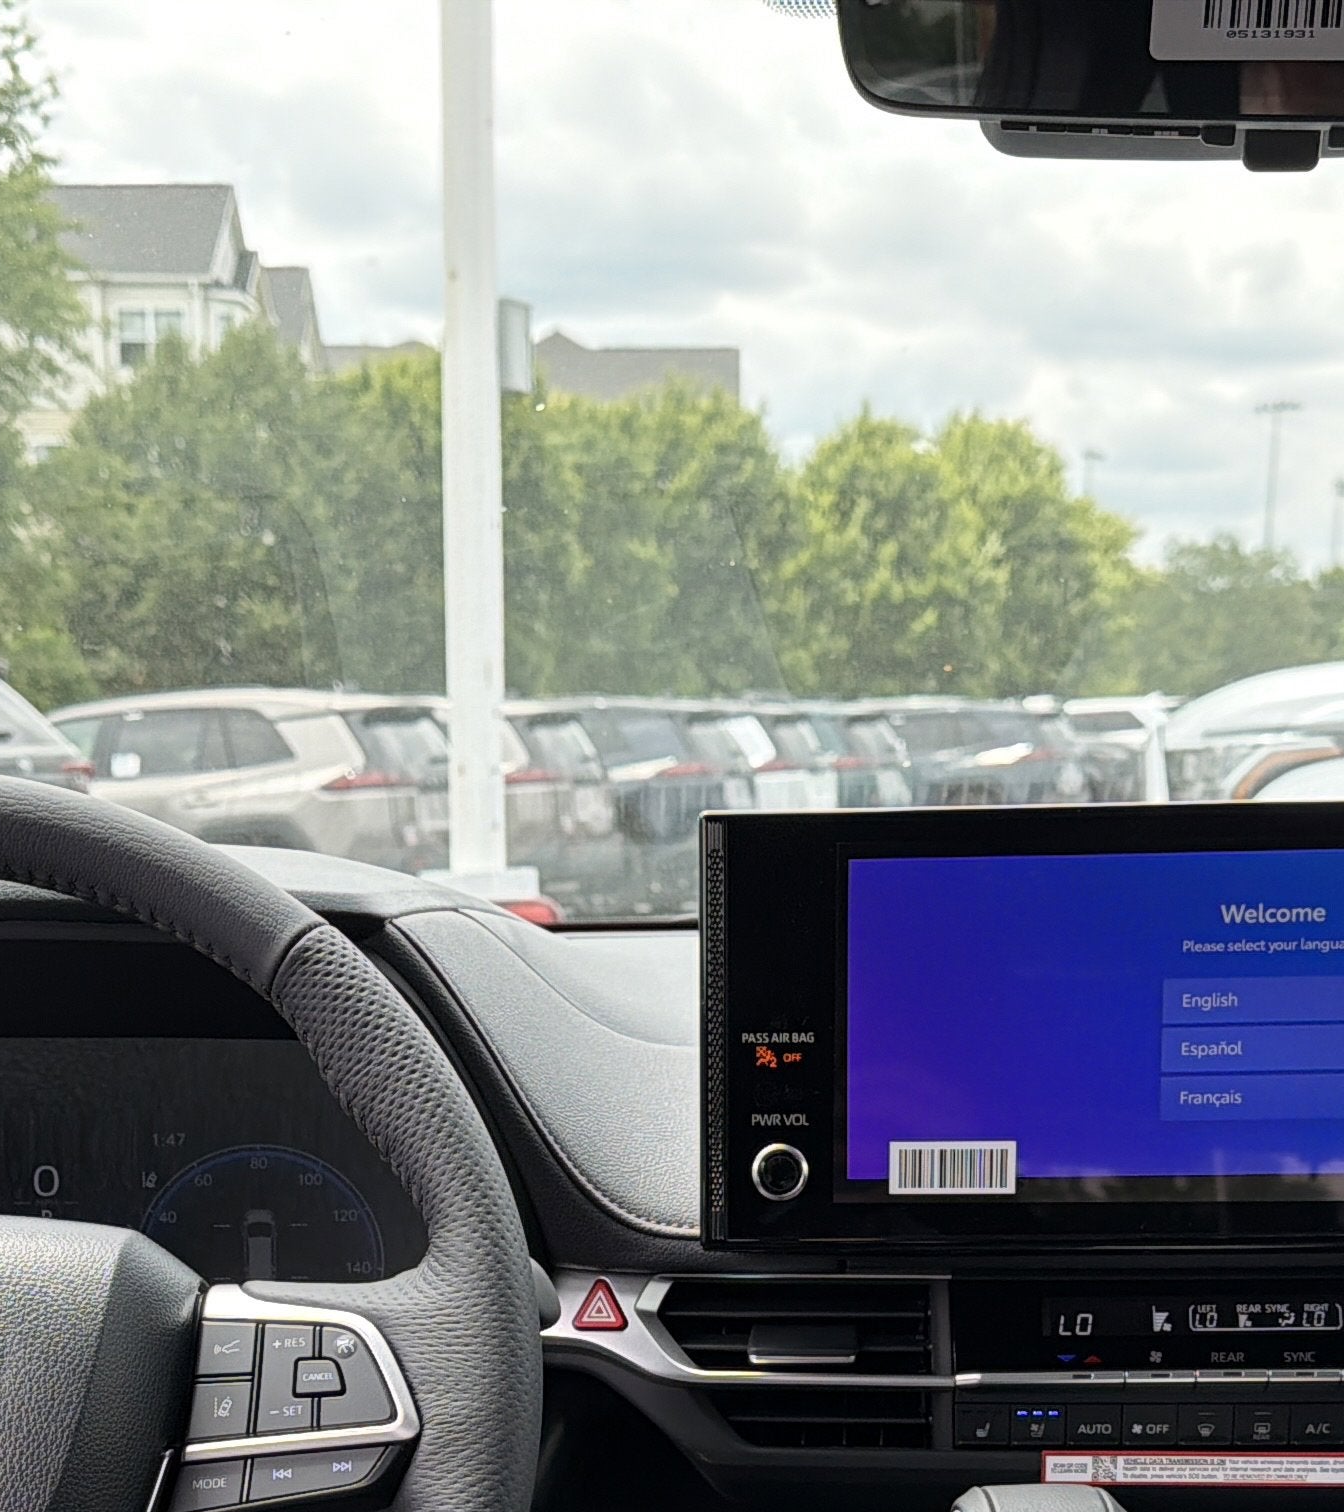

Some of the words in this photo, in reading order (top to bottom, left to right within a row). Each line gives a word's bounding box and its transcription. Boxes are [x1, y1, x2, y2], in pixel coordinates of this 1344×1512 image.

[1226, 29, 1315, 39] 05131931
[1220, 903, 1327, 924] Welcome
[1182, 940, 1225, 953] Please
[1227, 938, 1266, 952] select
[1268, 941, 1299, 954] your
[1182, 993, 1238, 1011] English
[741, 1032, 769, 1044] PASS
[771, 1032, 790, 1043] AIR
[792, 1031, 815, 1043] BAG
[1181, 1041, 1243, 1059] Español
[783, 1052, 803, 1063] OFF
[1179, 1090, 1243, 1108] Français
[751, 1113, 781, 1126] PWR
[783, 1113, 810, 1126] VOL
[153, 1133, 186, 1147] 1:47
[250, 1157, 268, 1170] 80
[33, 1165, 60, 1197] 0
[194, 1174, 213, 1187] 60
[299, 1173, 323, 1186] 100
[159, 1211, 177, 1224] 40
[333, 1210, 358, 1223] 120
[346, 1261, 372, 1275] 140
[1197, 1304, 1217, 1313] LEFT
[1236, 1303, 1262, 1313] REAR
[1264, 1303, 1291, 1313] SYNC
[1303, 1303, 1330, 1312] RIGHT
[1210, 1352, 1245, 1363] REAR
[1283, 1352, 1316, 1363] SYNC
[302, 1372, 334, 1382] CANCEL
[1077, 1424, 1112, 1434] AUTO
[1146, 1424, 1170, 1434] OFF
[1306, 1423, 1331, 1434] A/C
[192, 1478, 228, 1490] MODE
